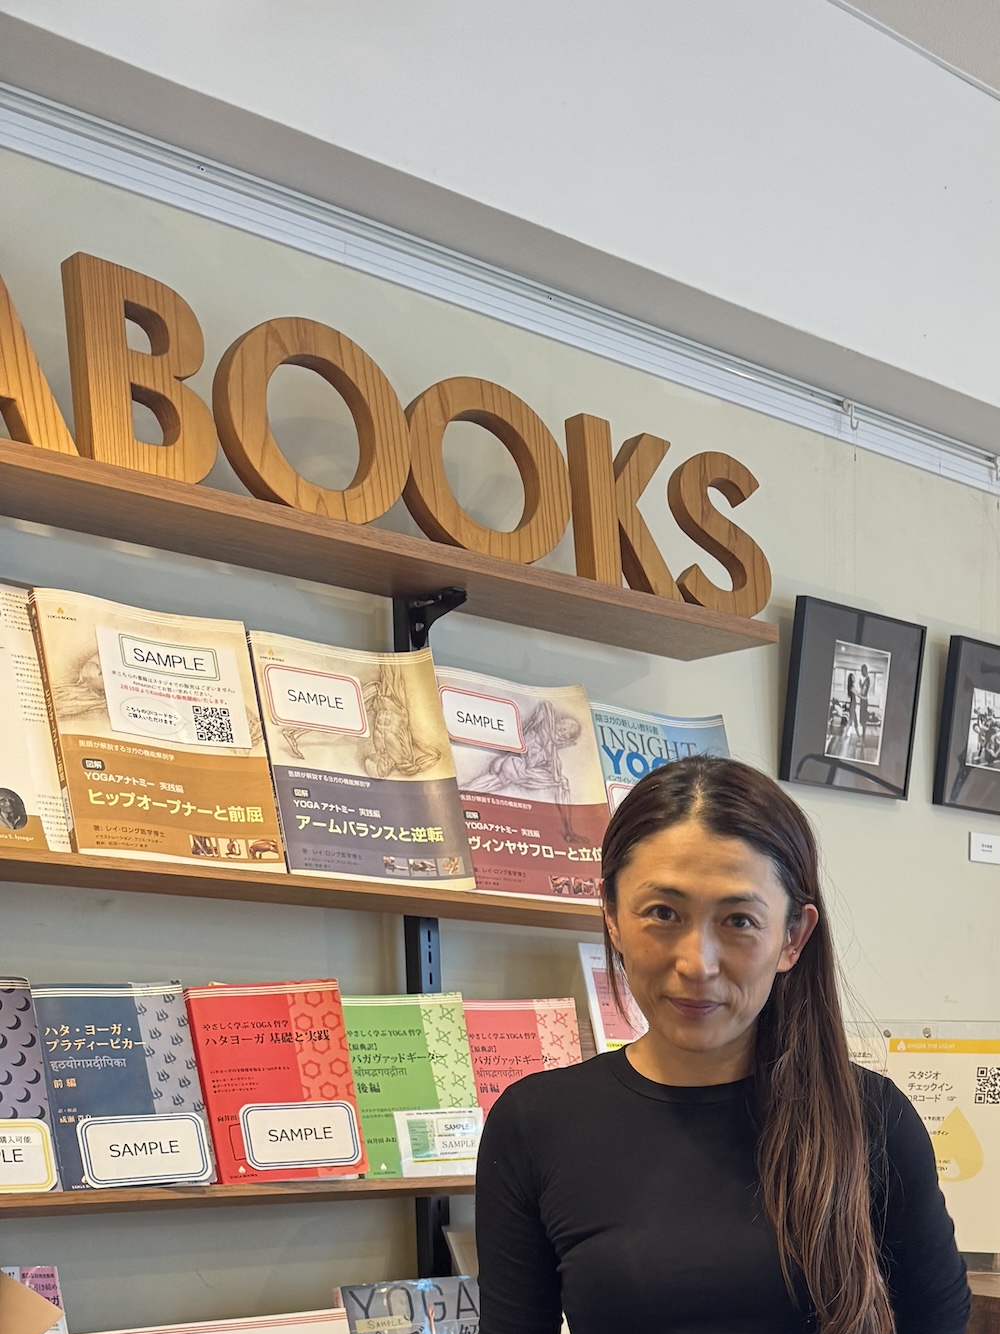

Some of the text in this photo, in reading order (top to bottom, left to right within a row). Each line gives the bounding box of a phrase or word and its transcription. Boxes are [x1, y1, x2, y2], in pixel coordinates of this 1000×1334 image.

[133, 647, 206, 672] SAMPLE
[287, 688, 345, 711] SAMPLE
[456, 711, 505, 732] SAMPLE
[598, 725, 697, 760] INSIGHT
[85, 760, 103, 769] 図解
[293, 788, 309, 797] 図解
[88, 789, 264, 823] ヒップオープナーと前屈
[295, 815, 444, 843] アームバランスと逆転
[46, 1038, 146, 1052] プラディーピカー
[205, 1029, 330, 1046] ハタヨーガ 基礎と実践
[52, 1077, 77, 1089] 前編
[909, 1071, 941, 1080] スタジオ
[357, 1082, 381, 1094] 後編
[479, 1083, 500, 1093] 前編
[907, 1082, 953, 1092] チェックイン
[268, 1126, 333, 1142] SAMPLE
[109, 1140, 181, 1158] SAMPLE
[442, 1140, 477, 1148] SAMPLE
[349, 1281, 480, 1322] YOGA
[368, 1319, 403, 1329] SAMPLE
